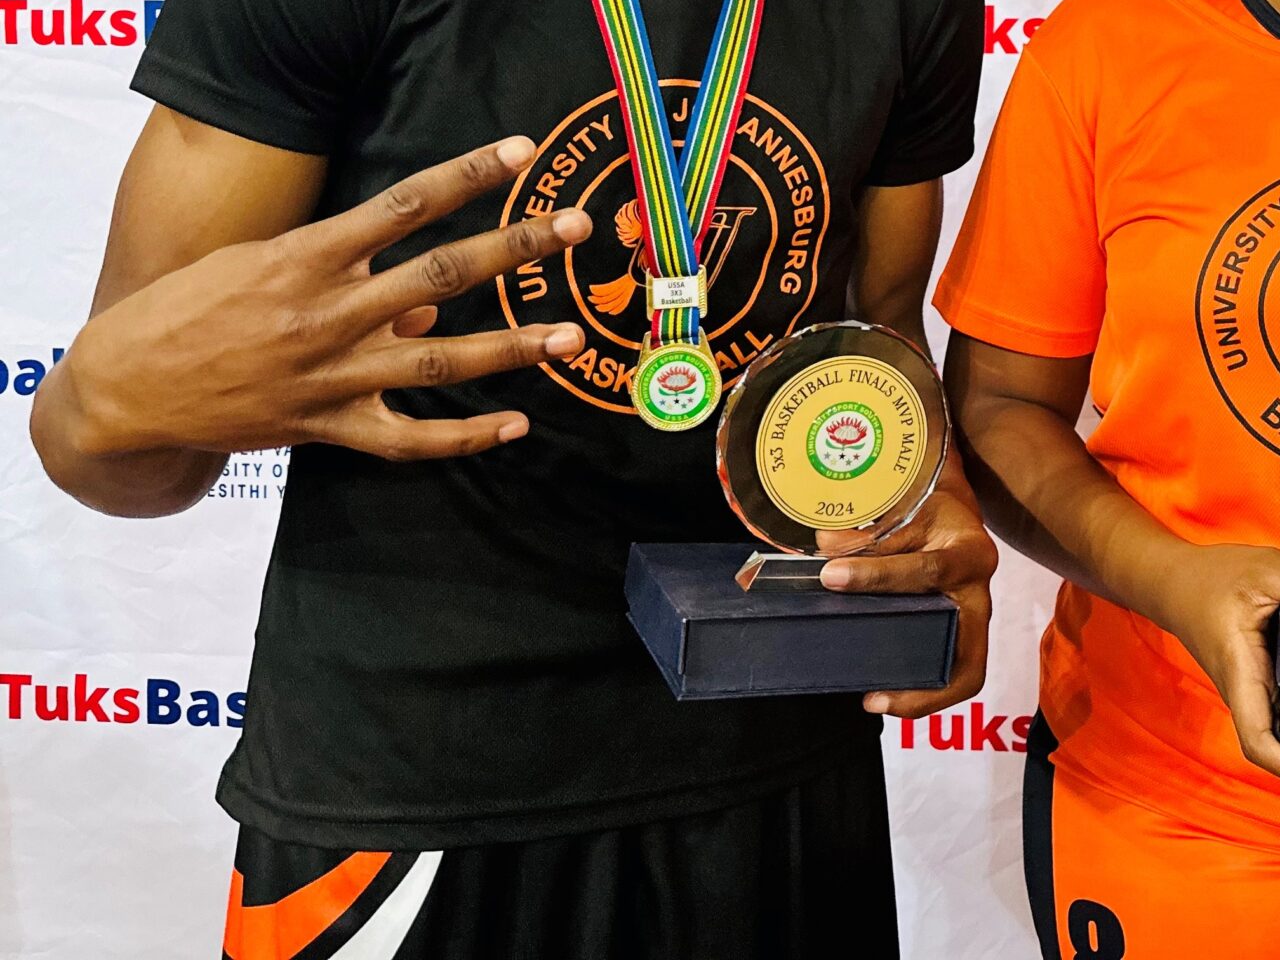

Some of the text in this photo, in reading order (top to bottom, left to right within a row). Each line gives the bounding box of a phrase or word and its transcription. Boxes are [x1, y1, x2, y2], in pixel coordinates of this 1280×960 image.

[516, 114, 614, 302] UNERSITY
[672, 98, 815, 295] JANNESBURG
[660, 296, 693, 305] Basketball
[769, 369, 915, 475] 3x3 BASKETBALL FINALS MVP MALE
[832, 403, 858, 414] SPORT
[859, 406, 880, 428] SOUTH
[814, 501, 855, 518] 2024
